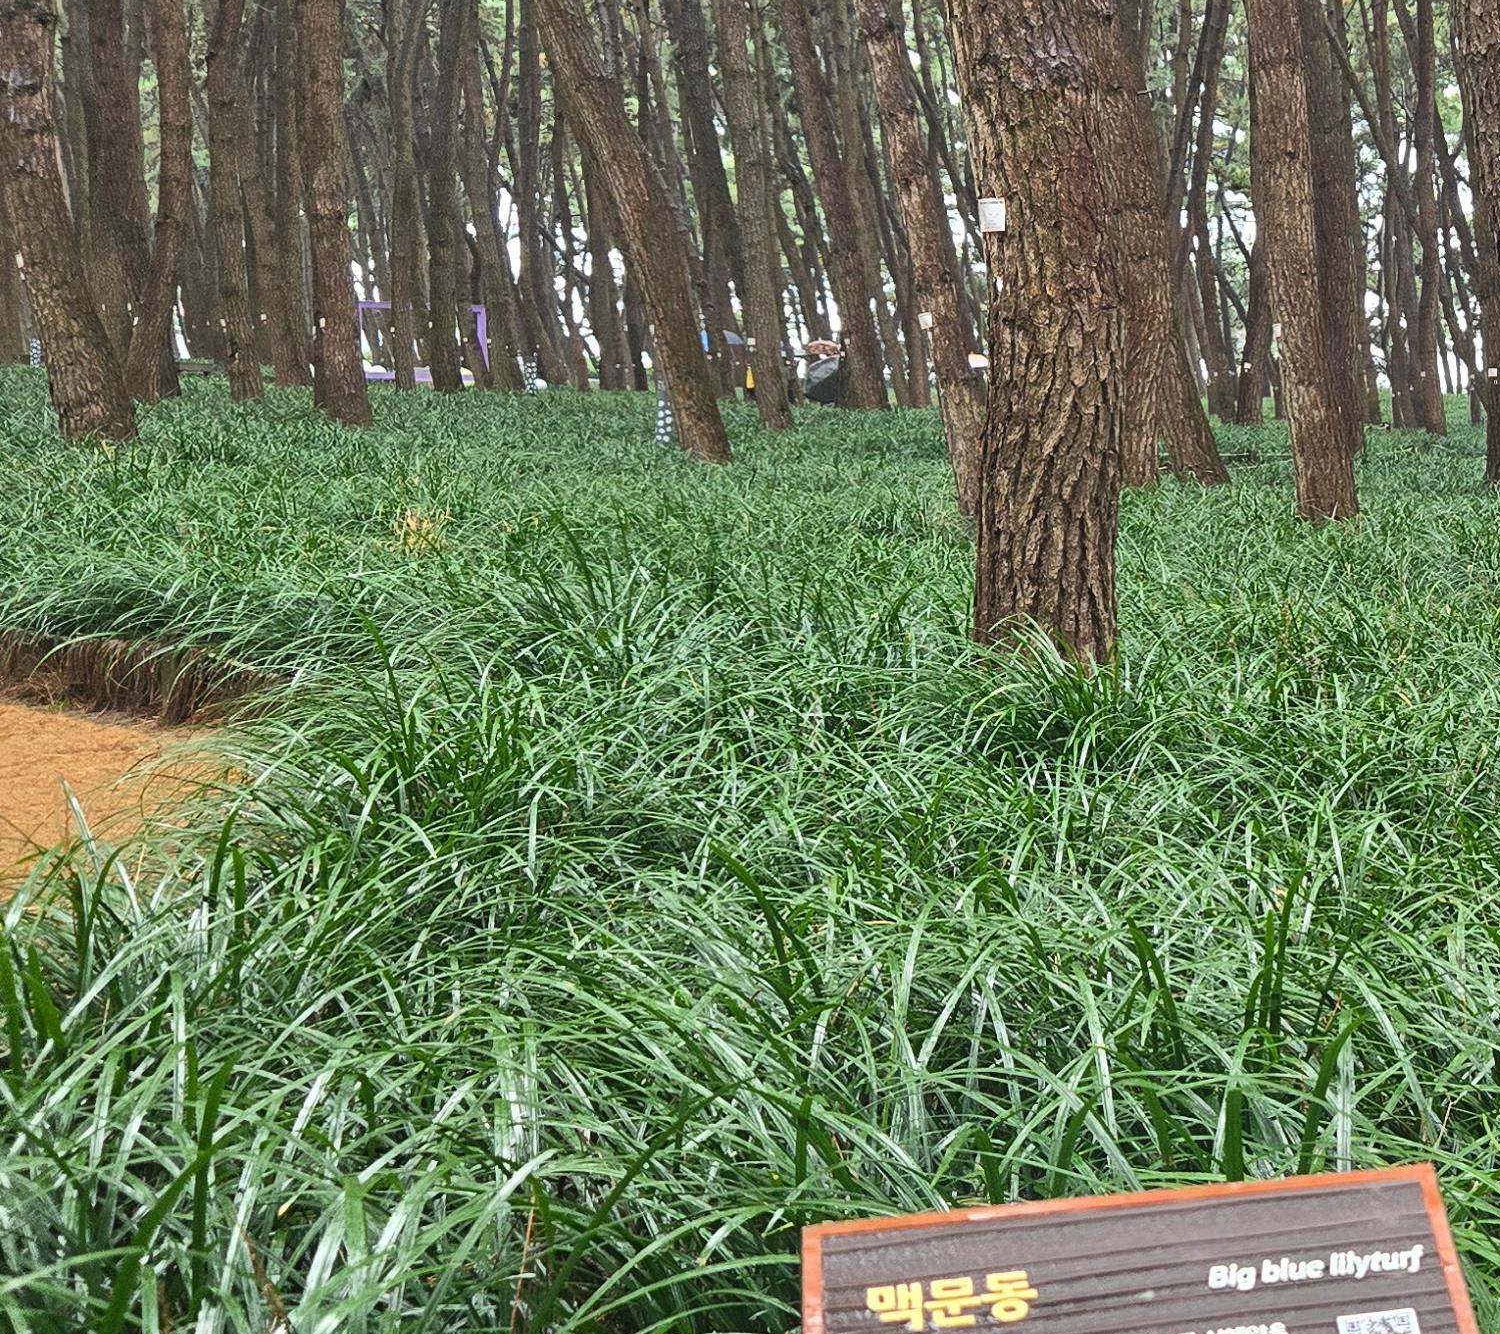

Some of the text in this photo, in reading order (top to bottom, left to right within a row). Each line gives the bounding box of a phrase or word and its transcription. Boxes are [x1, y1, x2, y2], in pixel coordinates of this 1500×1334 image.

[1208, 1244, 1424, 1291] Big blue lilyturf
[867, 1271, 1038, 1332] 맥문동
